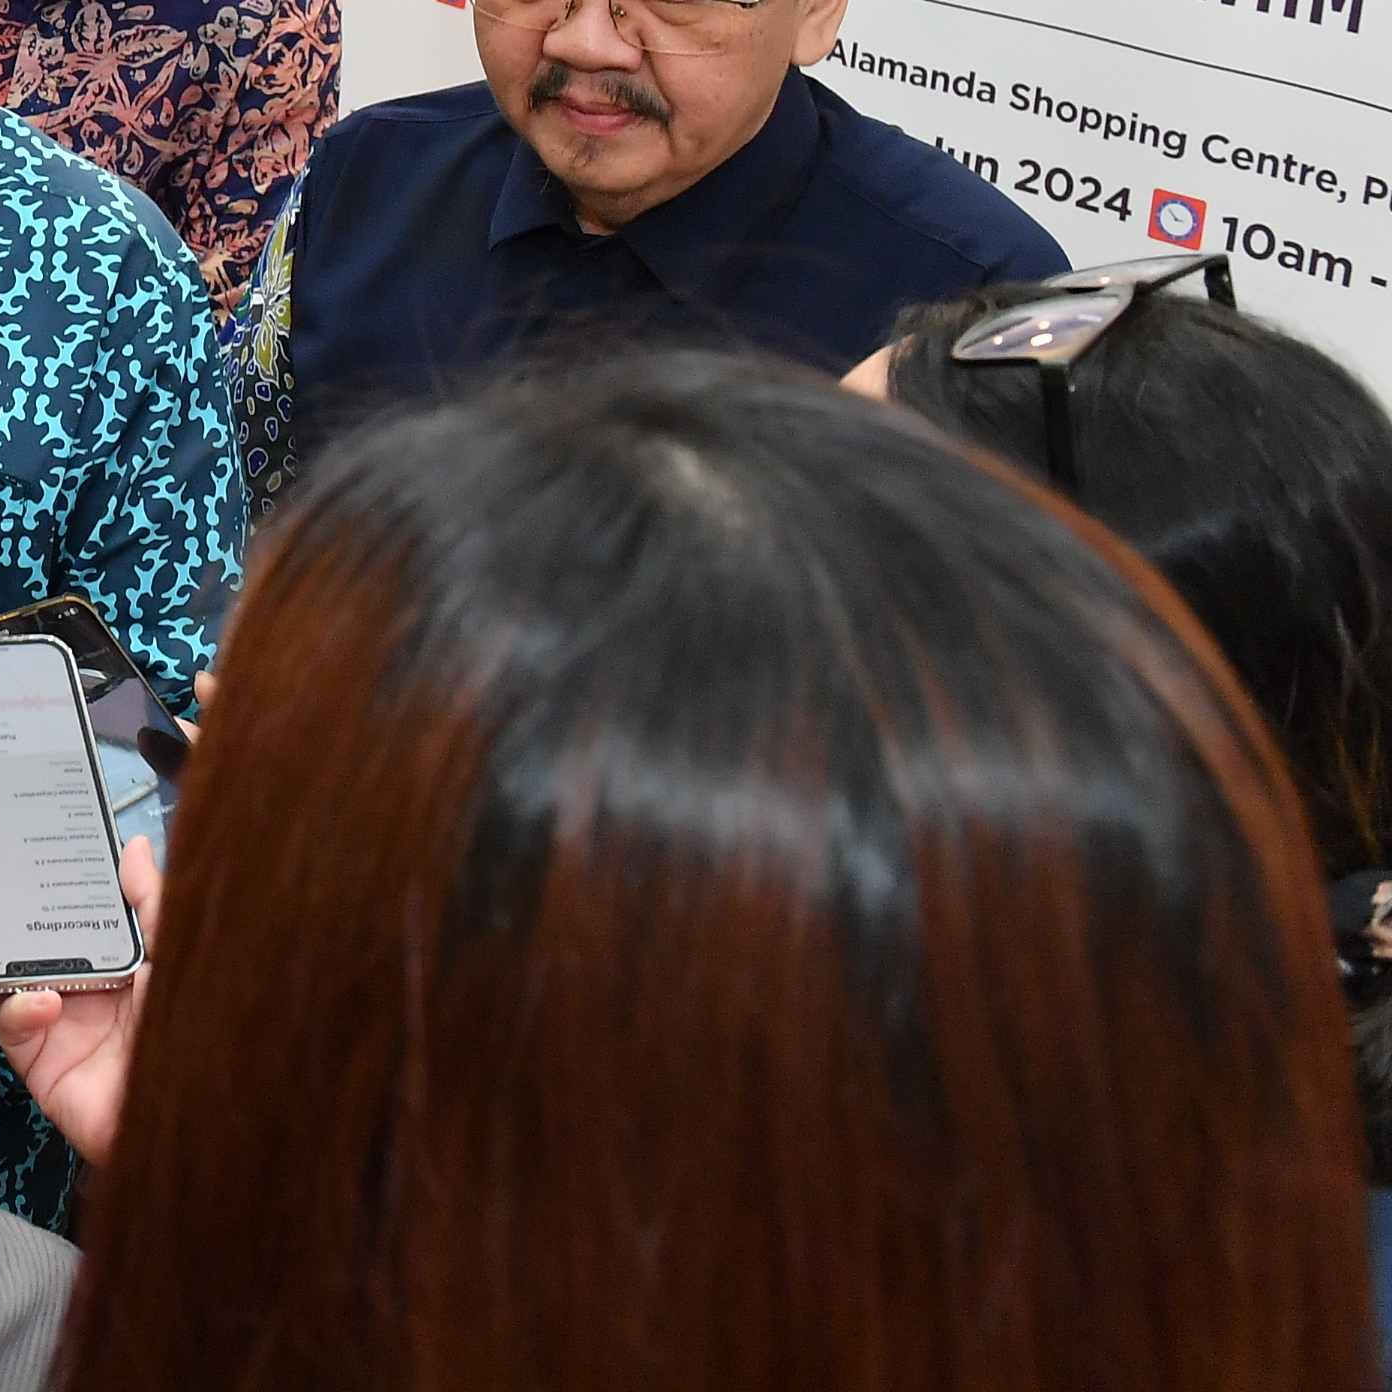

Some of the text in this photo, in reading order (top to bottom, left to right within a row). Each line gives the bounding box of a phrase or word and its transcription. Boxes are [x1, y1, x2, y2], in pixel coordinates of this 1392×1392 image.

[826, 38, 1392, 214] Alamanda Shopping Centre, P
[1014, 159, 1133, 223] 2024
[1222, 216, 1353, 289] 10am
[26, 918, 119, 932] All Recordings
